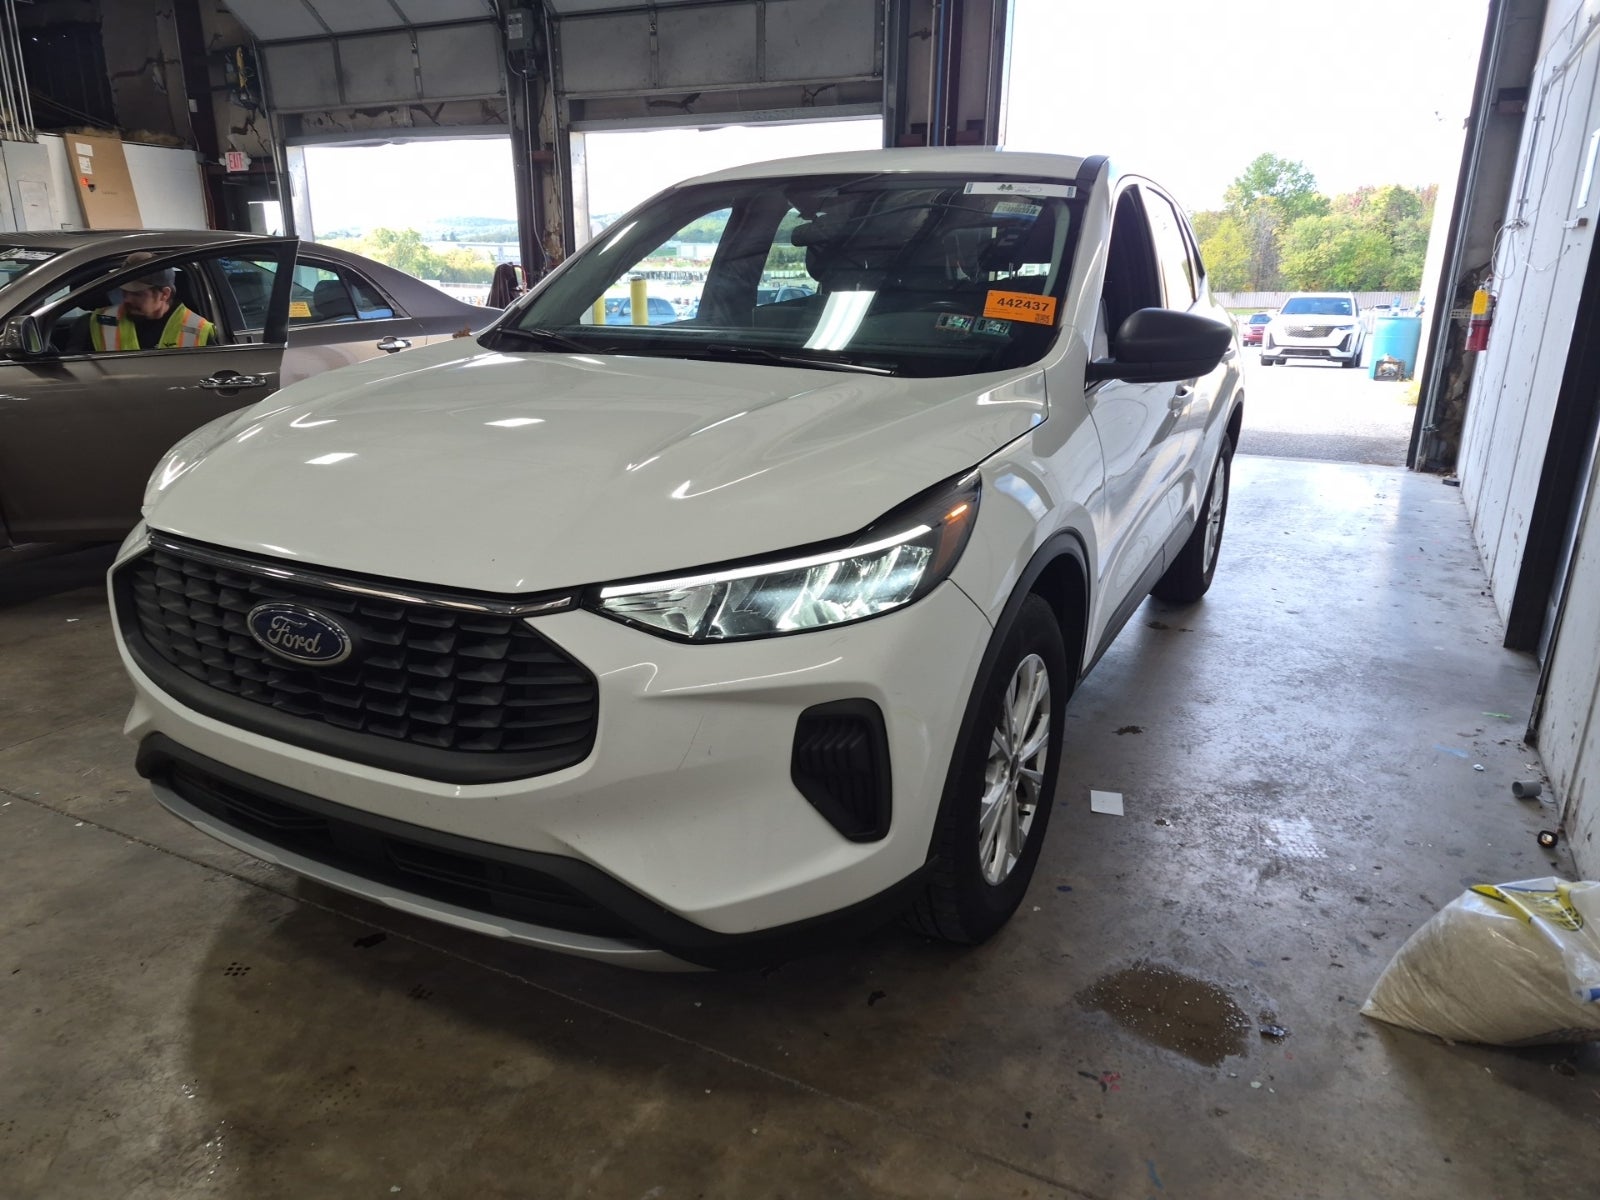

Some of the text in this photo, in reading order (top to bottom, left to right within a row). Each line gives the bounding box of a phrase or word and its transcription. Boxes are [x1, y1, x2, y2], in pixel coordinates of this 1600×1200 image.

[228, 153, 243, 170] EXIT
[997, 297, 1050, 311] 442437
[267, 616, 321, 654] Ford
